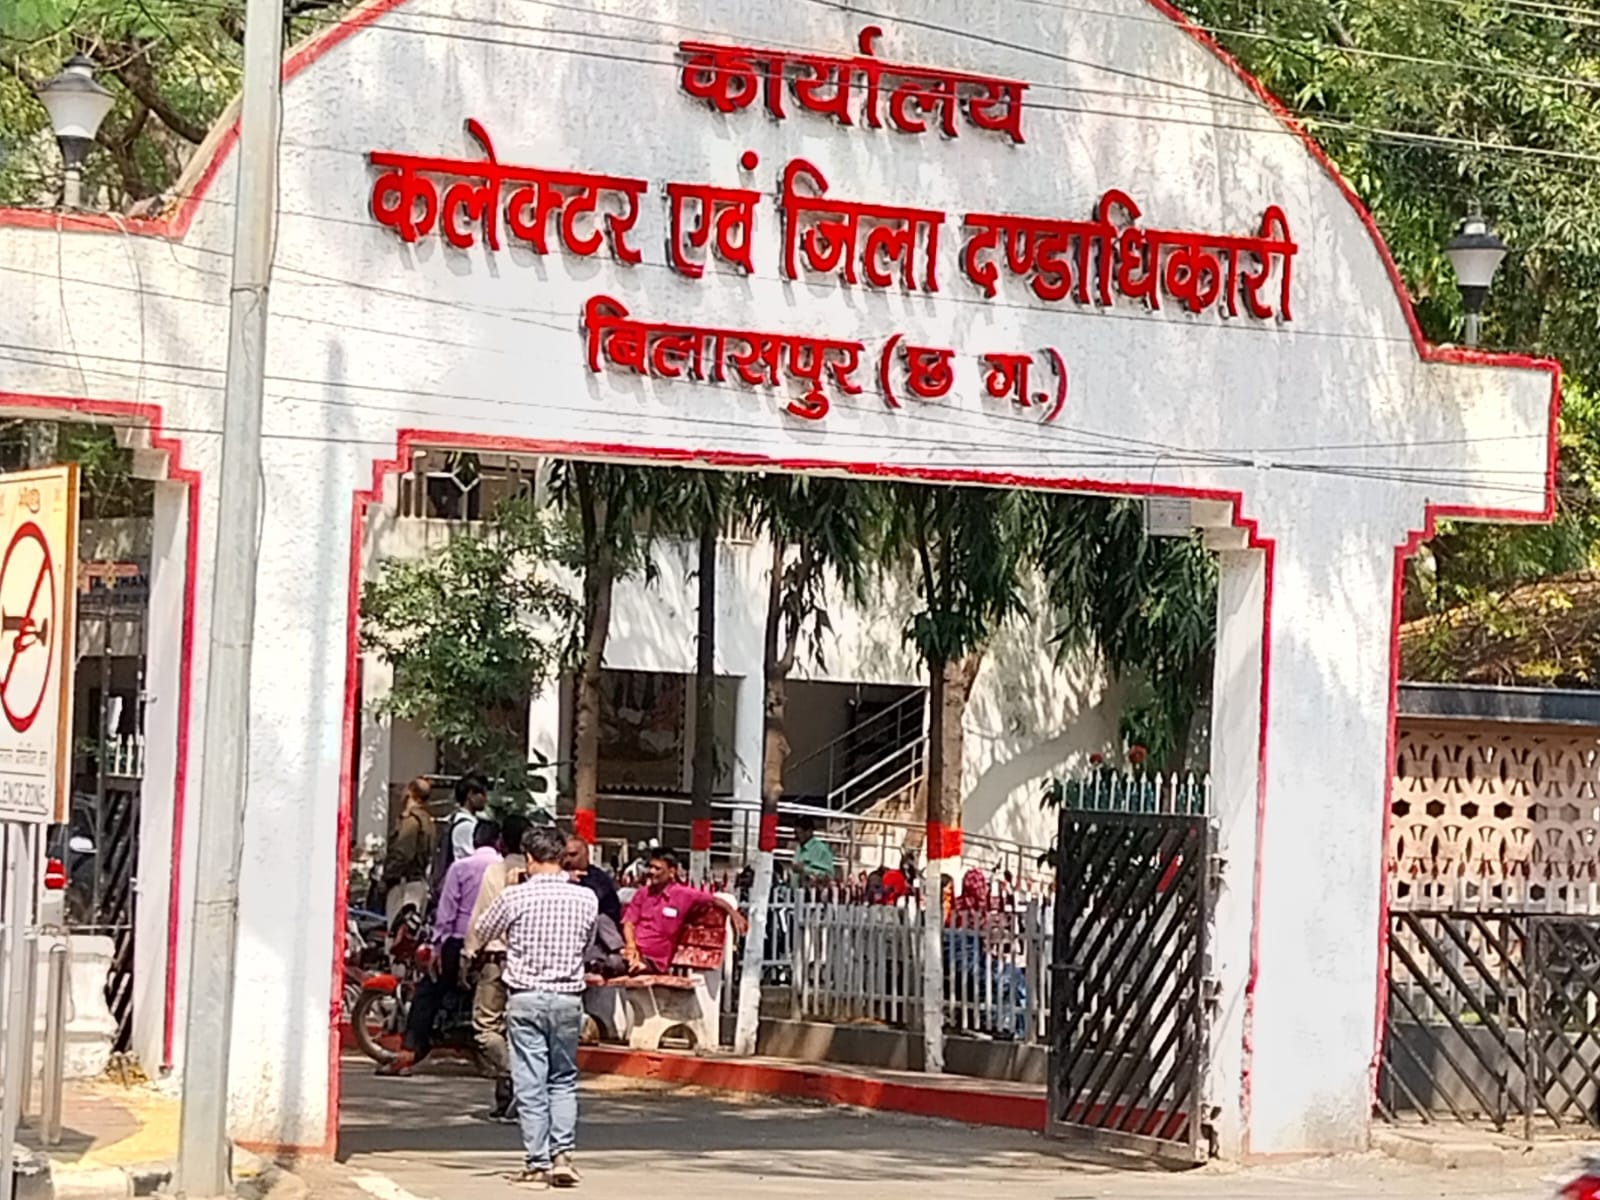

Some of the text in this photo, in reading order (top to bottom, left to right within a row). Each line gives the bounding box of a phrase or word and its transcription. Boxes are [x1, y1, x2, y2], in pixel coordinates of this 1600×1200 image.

[680, 26, 1029, 142] कार्यालय
[369, 118, 1298, 321] कलेक्टर एवं जिला दण्डाधिकारी
[584, 295, 864, 420] बिलासपुर
[880, 333, 956, 408] (छ
